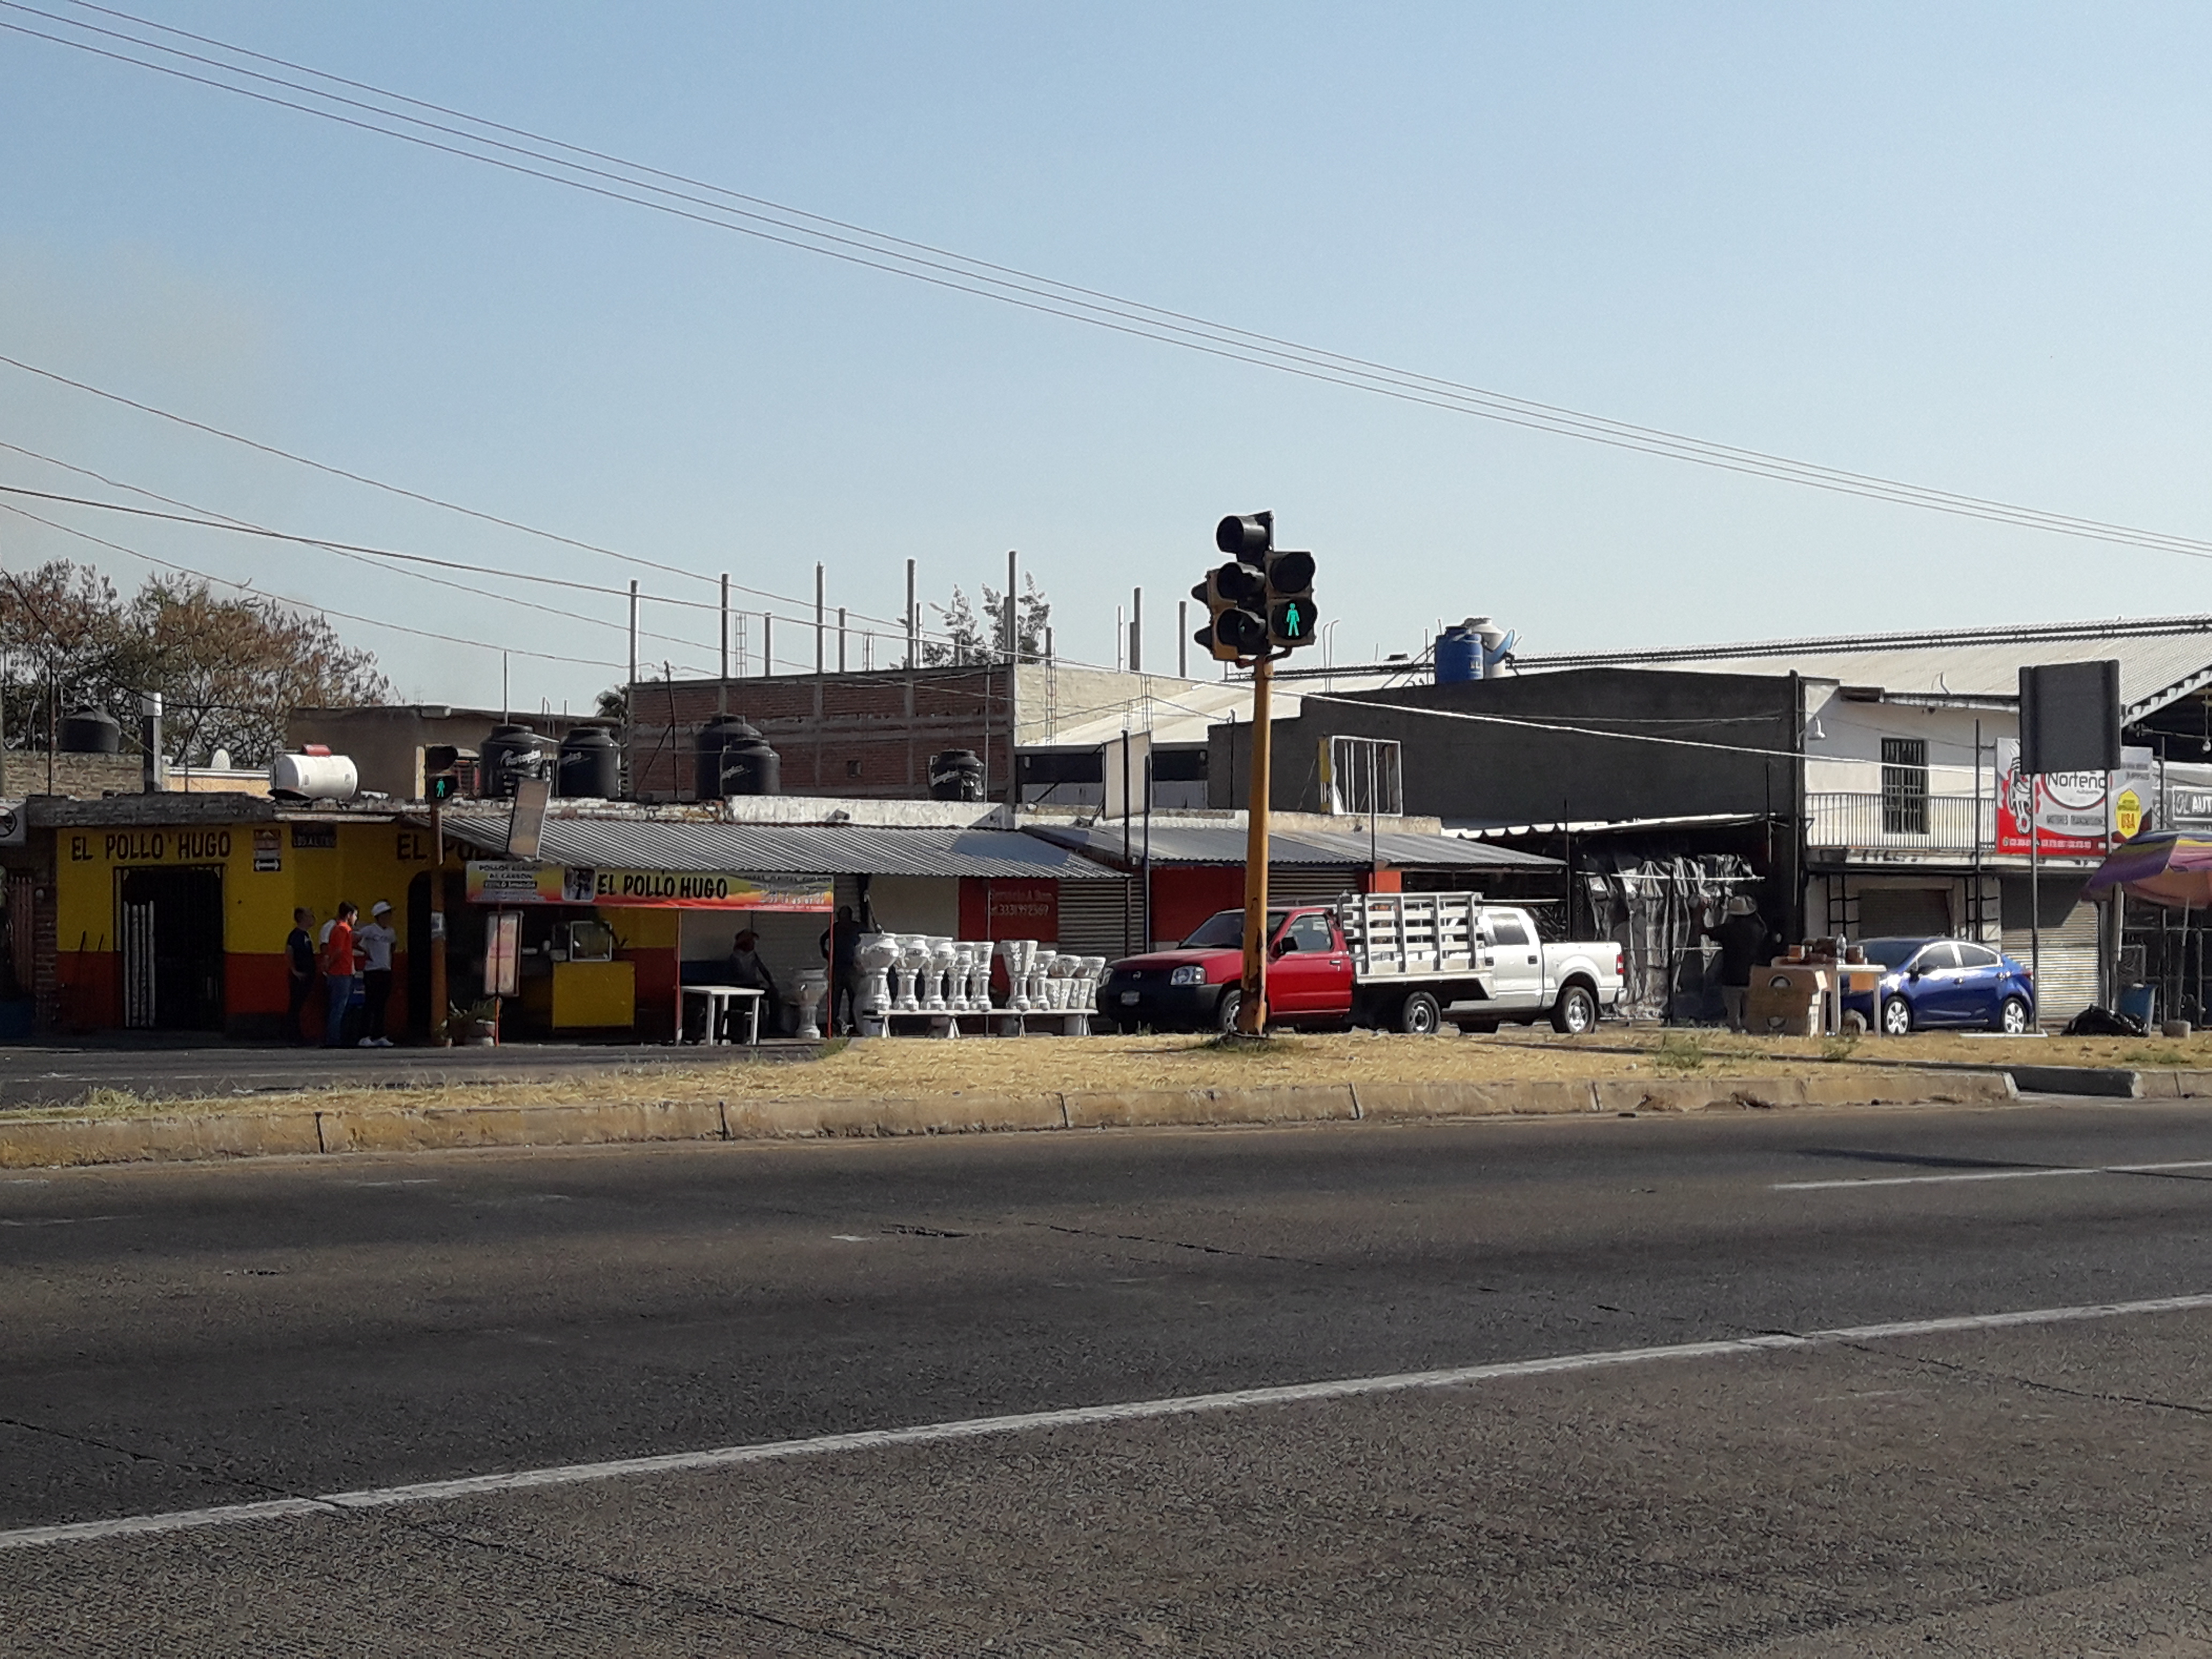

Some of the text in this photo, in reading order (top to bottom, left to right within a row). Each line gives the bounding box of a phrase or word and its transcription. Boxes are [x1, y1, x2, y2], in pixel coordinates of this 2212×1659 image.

[72, 836, 93, 861] EL
[178, 832, 230, 860] HUGO
[398, 834, 427, 860] EL
[597, 873, 617, 895] EL
[681, 877, 727, 899] HUGO
